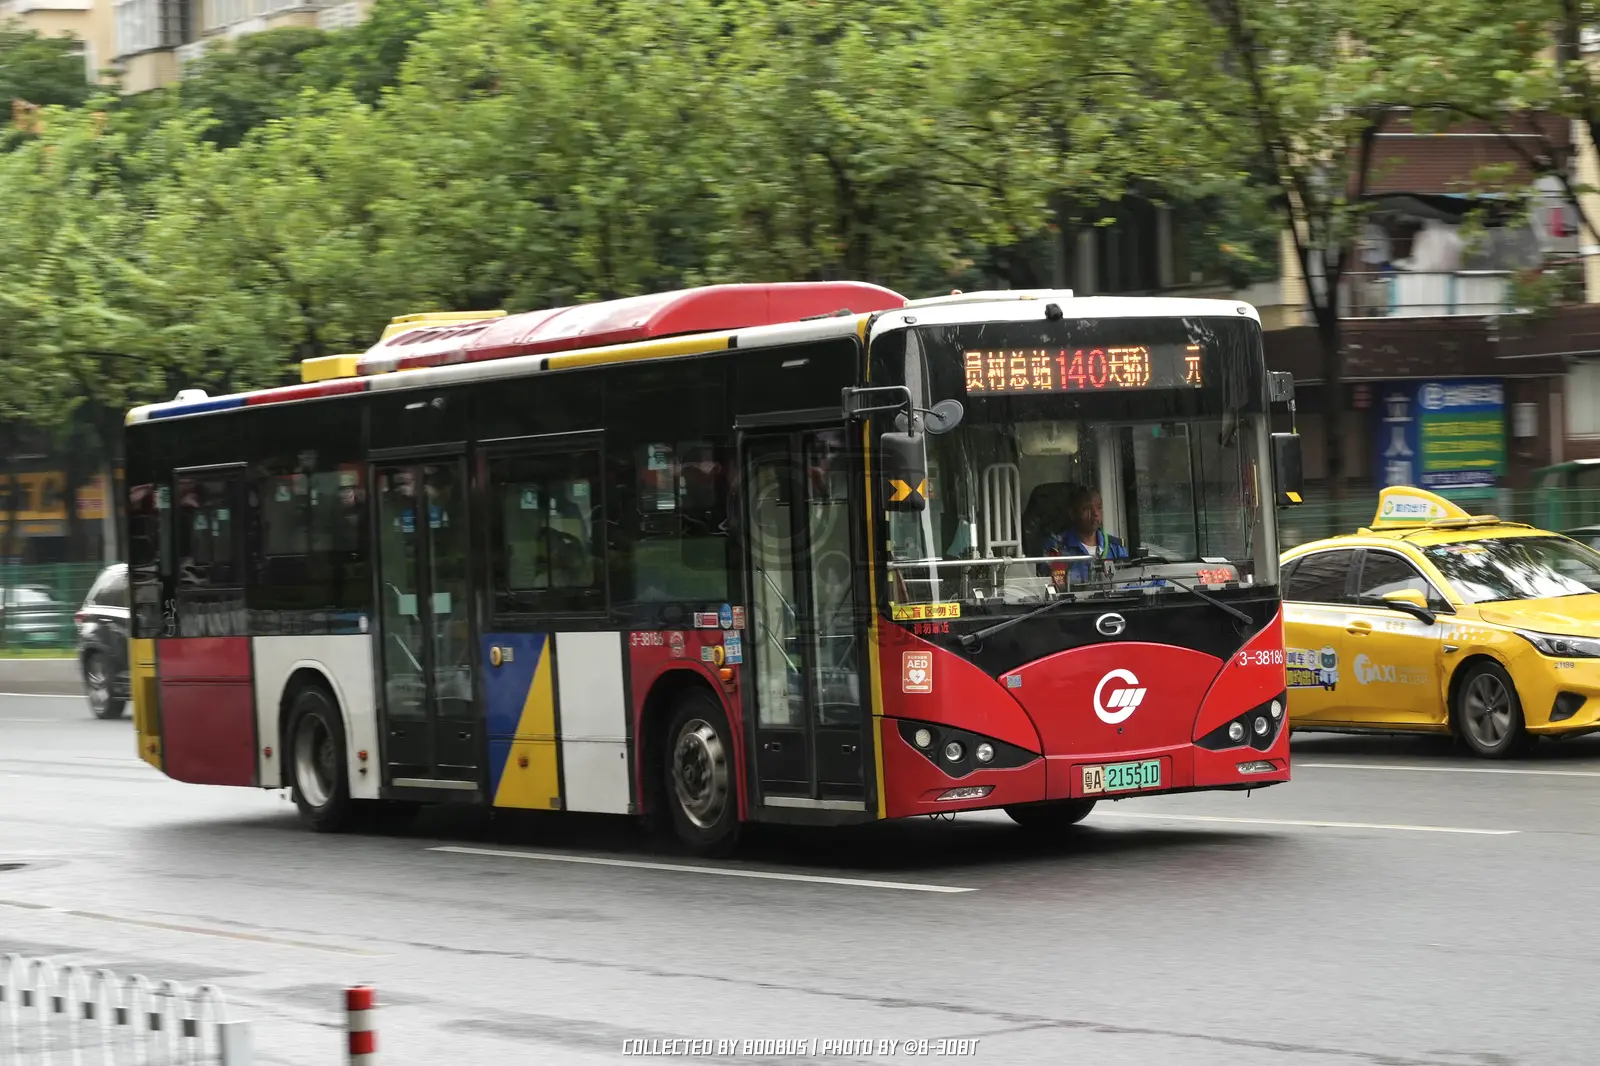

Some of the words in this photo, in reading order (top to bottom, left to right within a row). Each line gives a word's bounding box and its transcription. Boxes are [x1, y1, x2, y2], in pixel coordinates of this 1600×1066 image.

[1056, 349, 1107, 389] 140
[911, 605, 958, 618] 盲区勿近
[907, 660, 929, 669] AED
[1239, 650, 1284, 666] 3-38186
